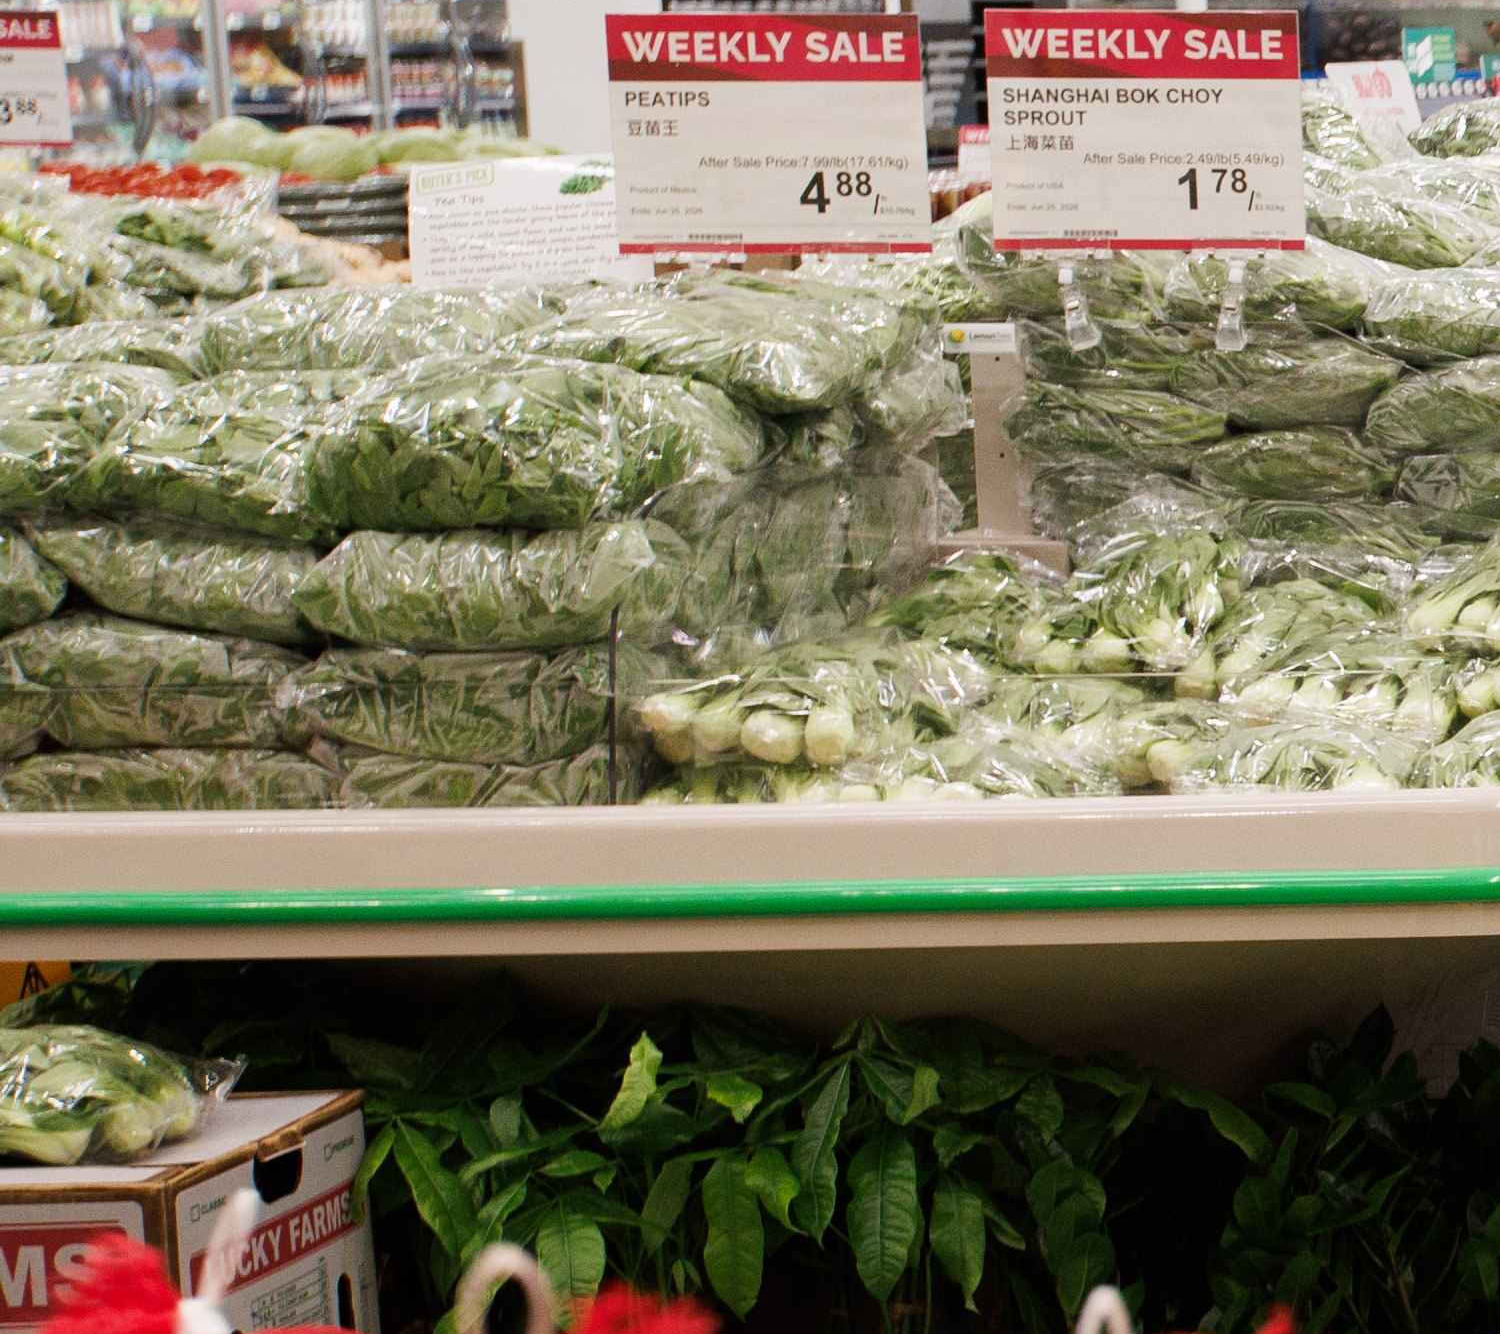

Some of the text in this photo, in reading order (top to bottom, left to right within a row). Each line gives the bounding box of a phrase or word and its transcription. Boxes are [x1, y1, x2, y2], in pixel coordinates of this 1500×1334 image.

[621, 31, 906, 63] WEEKLY SALE
[1001, 28, 1285, 61] WEEKLY SALE
[624, 91, 711, 108] PEATIPS
[1003, 87, 1224, 105] SHANGHAI BOK CHOY
[1003, 110, 1087, 126] SPROUT
[1005, 134, 1075, 152] 上海菜苗
[698, 155, 730, 169] After
[732, 155, 762, 169] Sale
[1083, 152, 1114, 165] After
[1117, 152, 1147, 165] Sale
[420, 168, 489, 190] BUYER'S PICK
